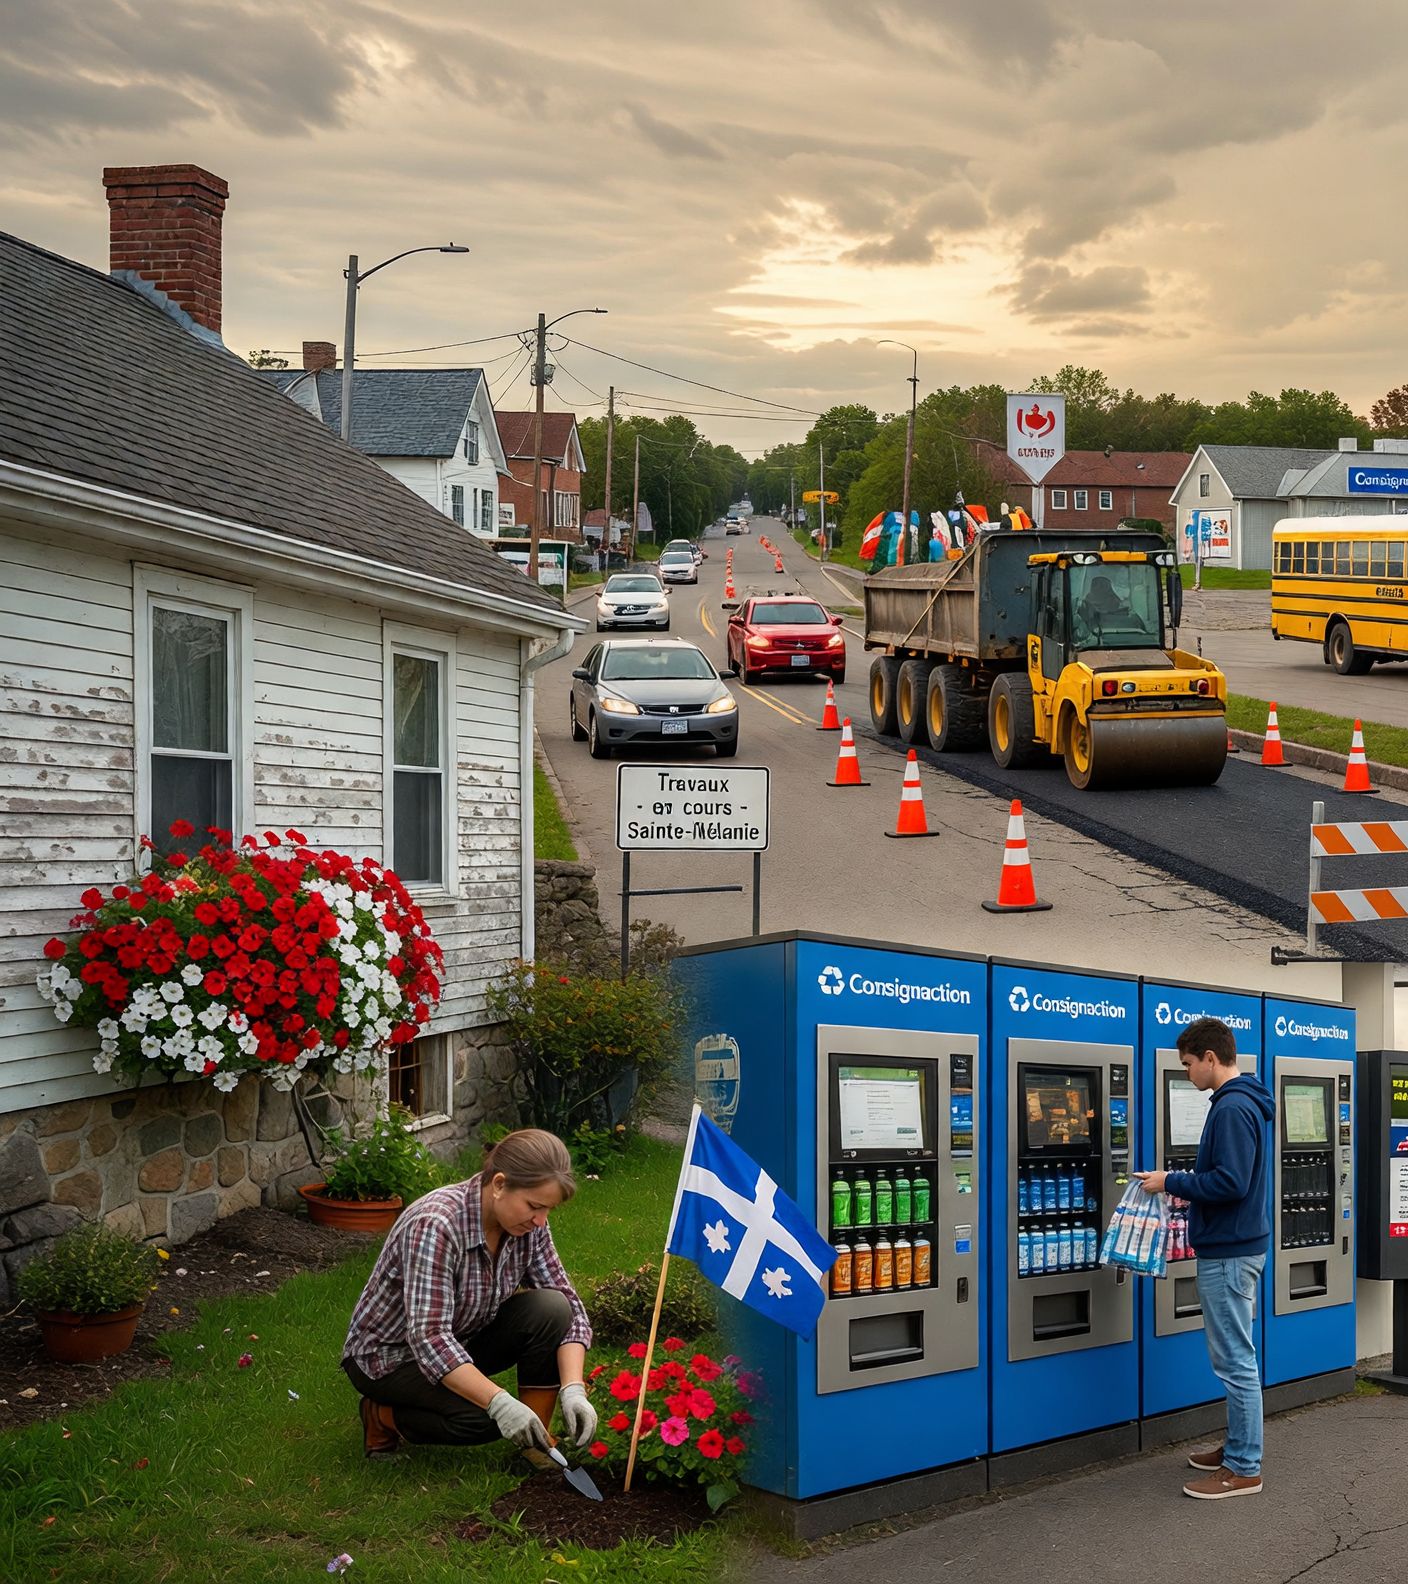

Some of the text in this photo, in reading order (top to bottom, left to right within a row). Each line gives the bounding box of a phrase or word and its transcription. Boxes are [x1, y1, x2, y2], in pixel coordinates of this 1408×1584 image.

[658, 773, 729, 792] Travaux
[684, 802, 732, 816] cours
[850, 974, 970, 1004] Consignaction
[1033, 994, 1125, 1018] Consignaction
